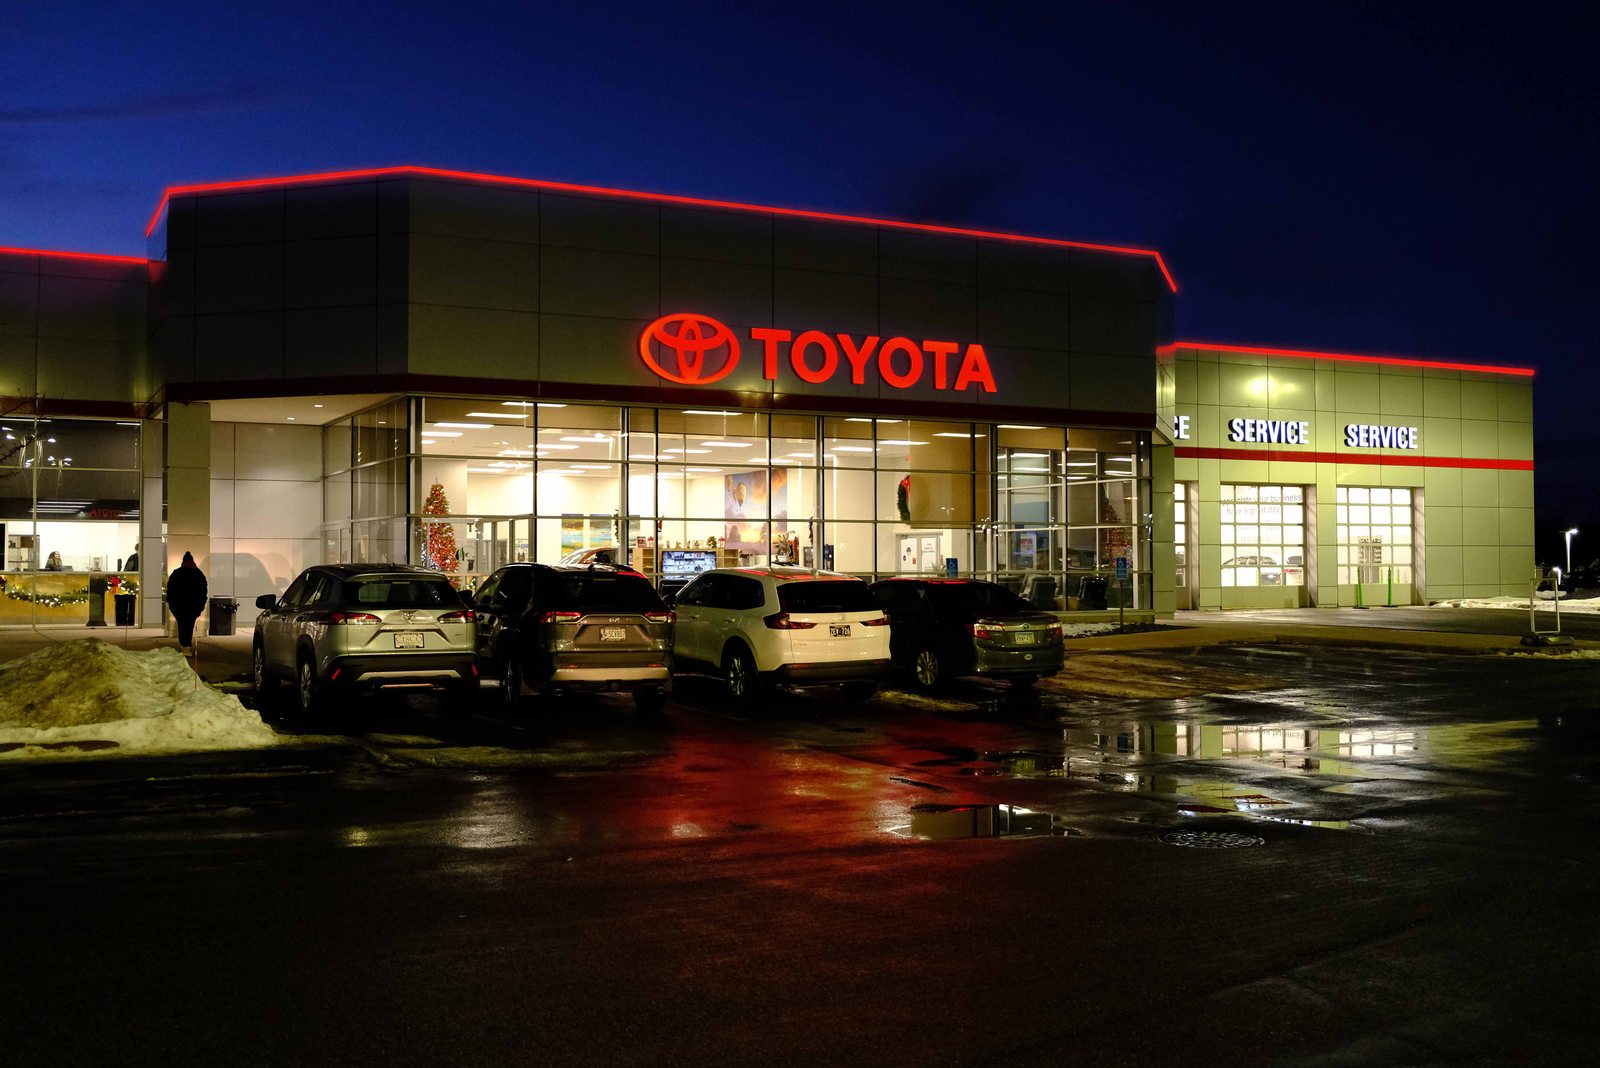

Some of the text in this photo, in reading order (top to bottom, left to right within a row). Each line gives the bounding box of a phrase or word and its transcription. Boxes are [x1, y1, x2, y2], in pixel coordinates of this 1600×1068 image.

[751, 327, 997, 393] TOYOTA
[1229, 417, 1309, 445] SERVICE
[1345, 424, 1418, 449] SERVICE
[395, 635, 423, 643] CISCO
